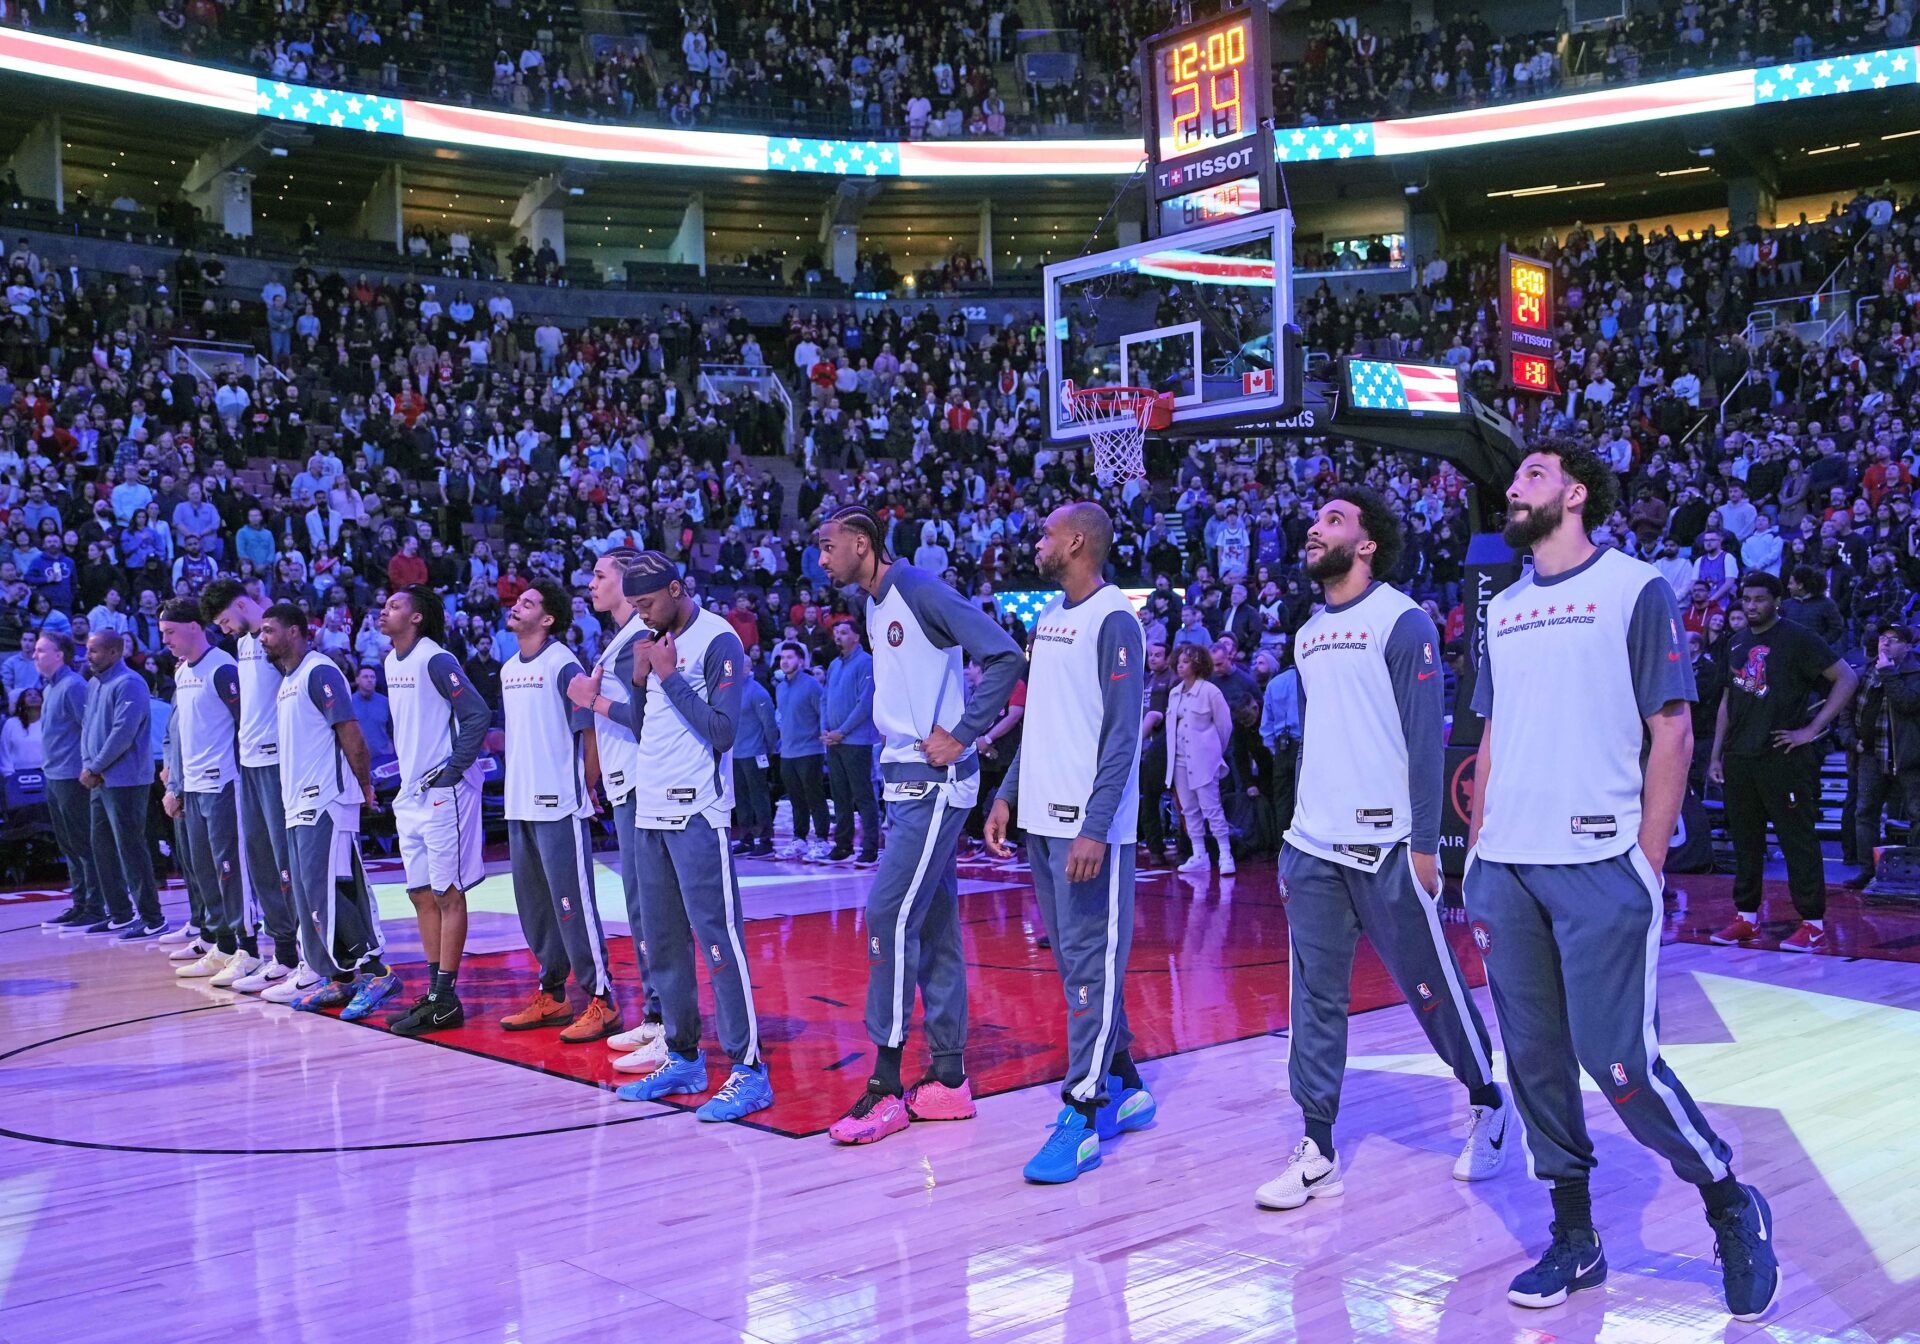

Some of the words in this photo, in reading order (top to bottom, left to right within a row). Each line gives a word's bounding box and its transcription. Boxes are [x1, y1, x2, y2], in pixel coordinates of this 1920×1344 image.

[1172, 26, 1245, 83] 12:00
[1171, 68, 1242, 151] 24
[1184, 147, 1253, 182] TISSOT
[961, 306, 987, 320] 122
[1517, 292, 1540, 323] 24
[1523, 333, 1552, 348] TISSOT
[1476, 571, 1492, 623] CITY
[1497, 619, 1546, 638] WASHINGTON
[1547, 615, 1596, 626] WIZARDS
[1332, 642, 1368, 650] WIZARDS
[1439, 835, 1465, 848] AIR
